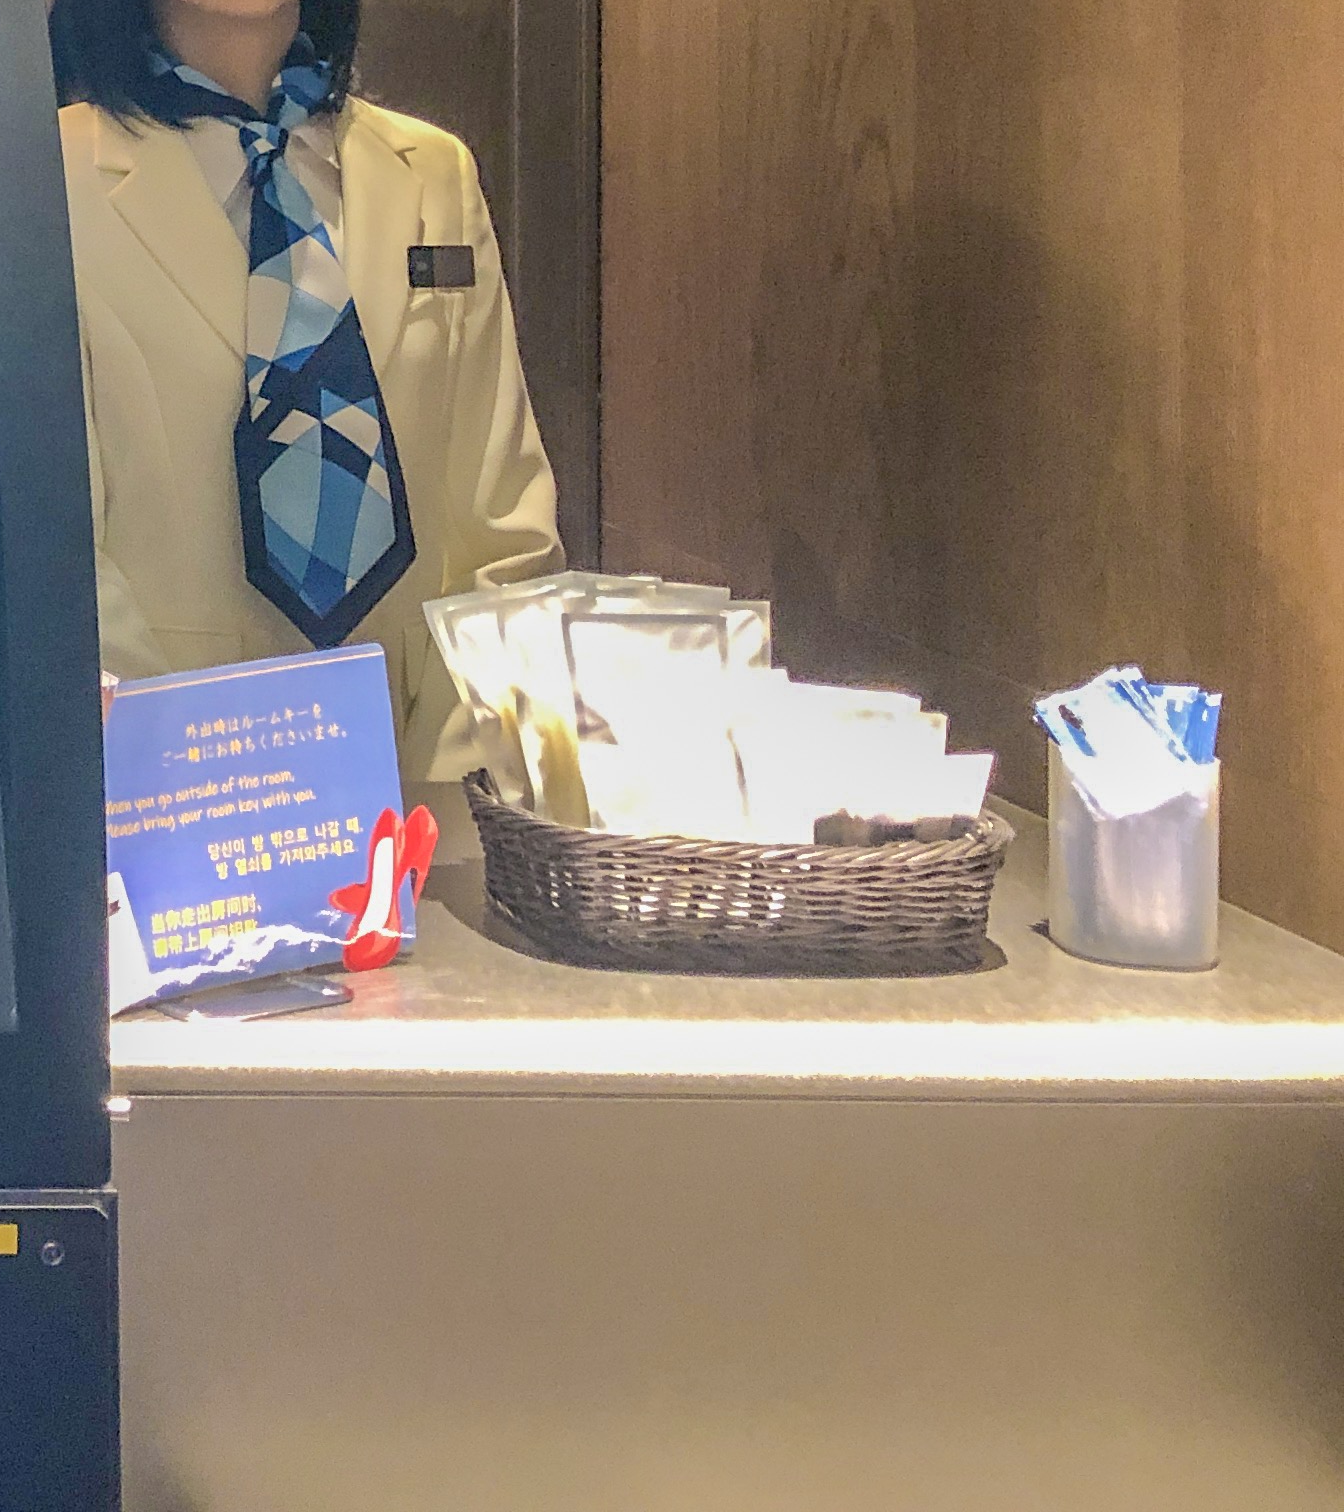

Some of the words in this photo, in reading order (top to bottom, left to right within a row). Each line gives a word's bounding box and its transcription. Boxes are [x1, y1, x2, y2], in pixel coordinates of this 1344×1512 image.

[106, 801, 132, 816] hen
[135, 797, 155, 813] you
[158, 794, 172, 811] go
[176, 780, 218, 802] outside
[221, 776, 235, 794] of
[238, 776, 259, 790] the
[144, 815, 176, 833] bring
[178, 809, 203, 827] your
[206, 803, 236, 819] room
[238, 799, 260, 814] key
[262, 791, 290, 809] with
[207, 838, 245, 861] 당신이
[314, 820, 340, 839] 나갈
